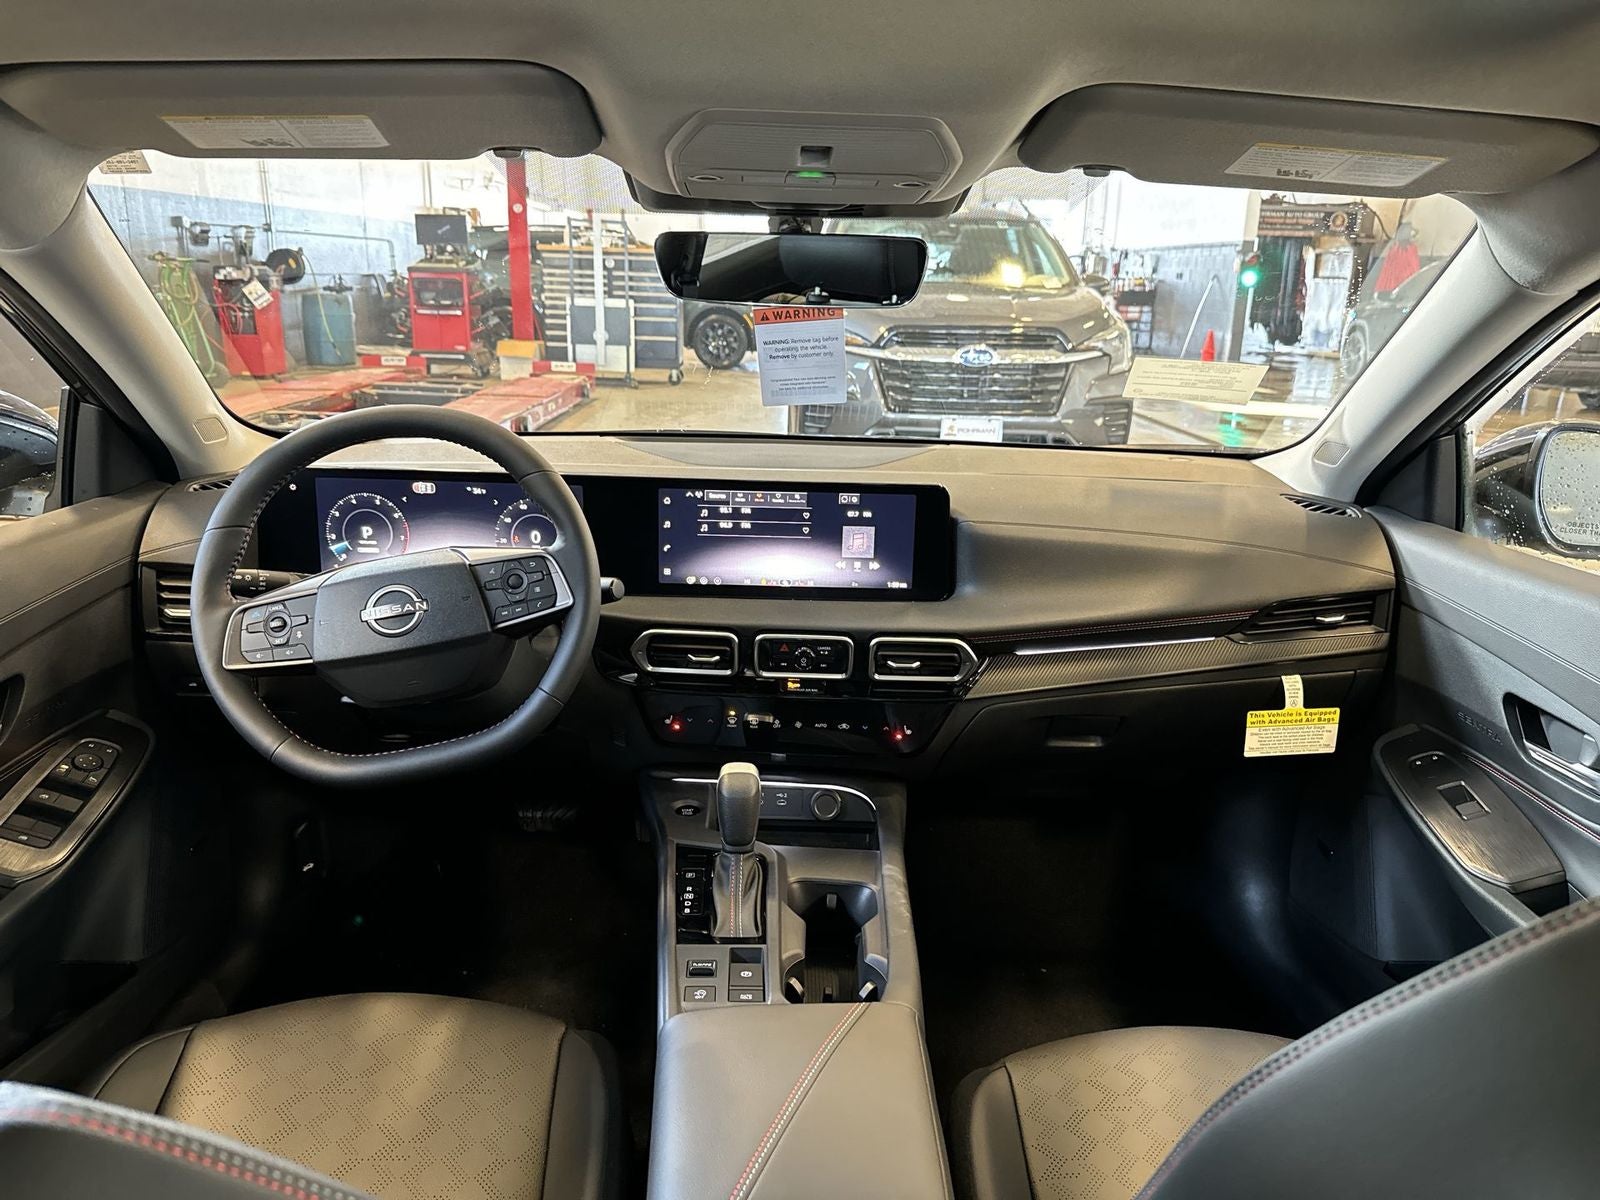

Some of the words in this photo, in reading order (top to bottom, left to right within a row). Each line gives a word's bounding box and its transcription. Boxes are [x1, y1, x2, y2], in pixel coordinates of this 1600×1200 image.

[772, 308, 836, 320] WARNING
[1559, 527, 1588, 535] CLOSER
[1567, 521, 1599, 529] OBJECTS
[361, 526, 373, 539] P
[531, 530, 541, 544] 0
[363, 601, 427, 619] NISSAN
[1457, 711, 1503, 745] SENTRA
